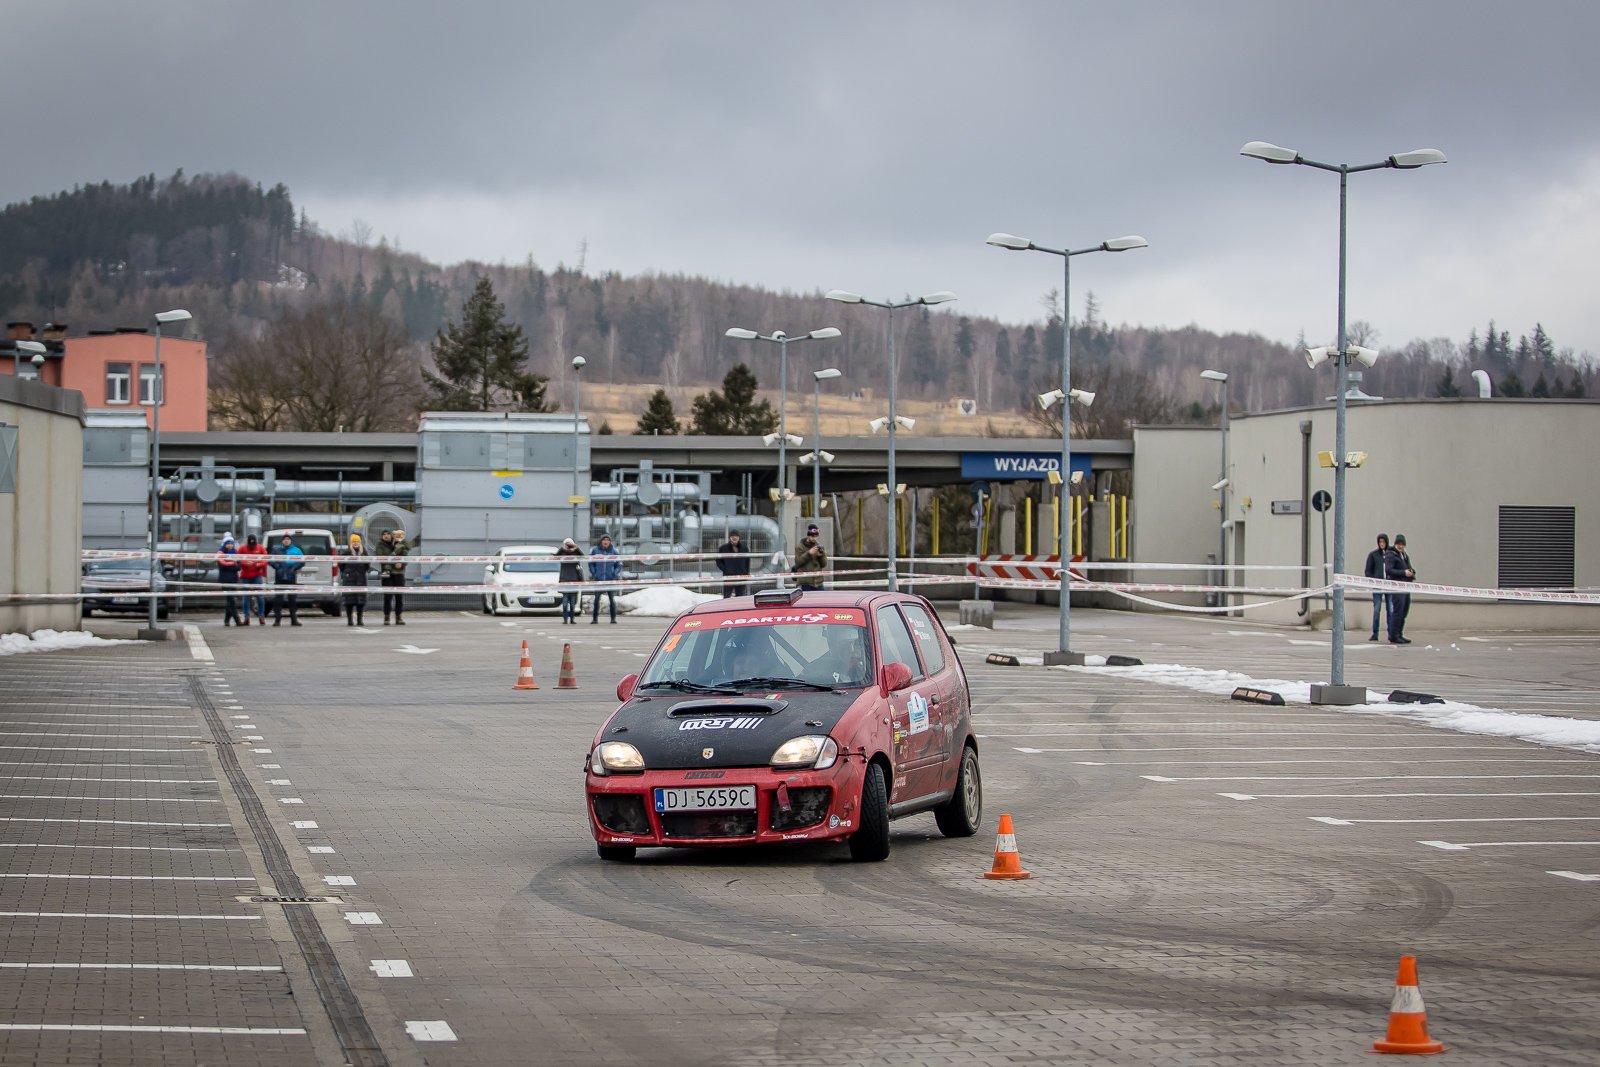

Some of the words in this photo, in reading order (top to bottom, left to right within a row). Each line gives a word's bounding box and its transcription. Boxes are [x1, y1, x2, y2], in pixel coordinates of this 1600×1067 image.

[994, 457, 1060, 472] WYJAZD
[720, 615, 801, 626] ABARTH
[667, 790, 689, 809] DJ
[696, 788, 751, 808] 5659C
